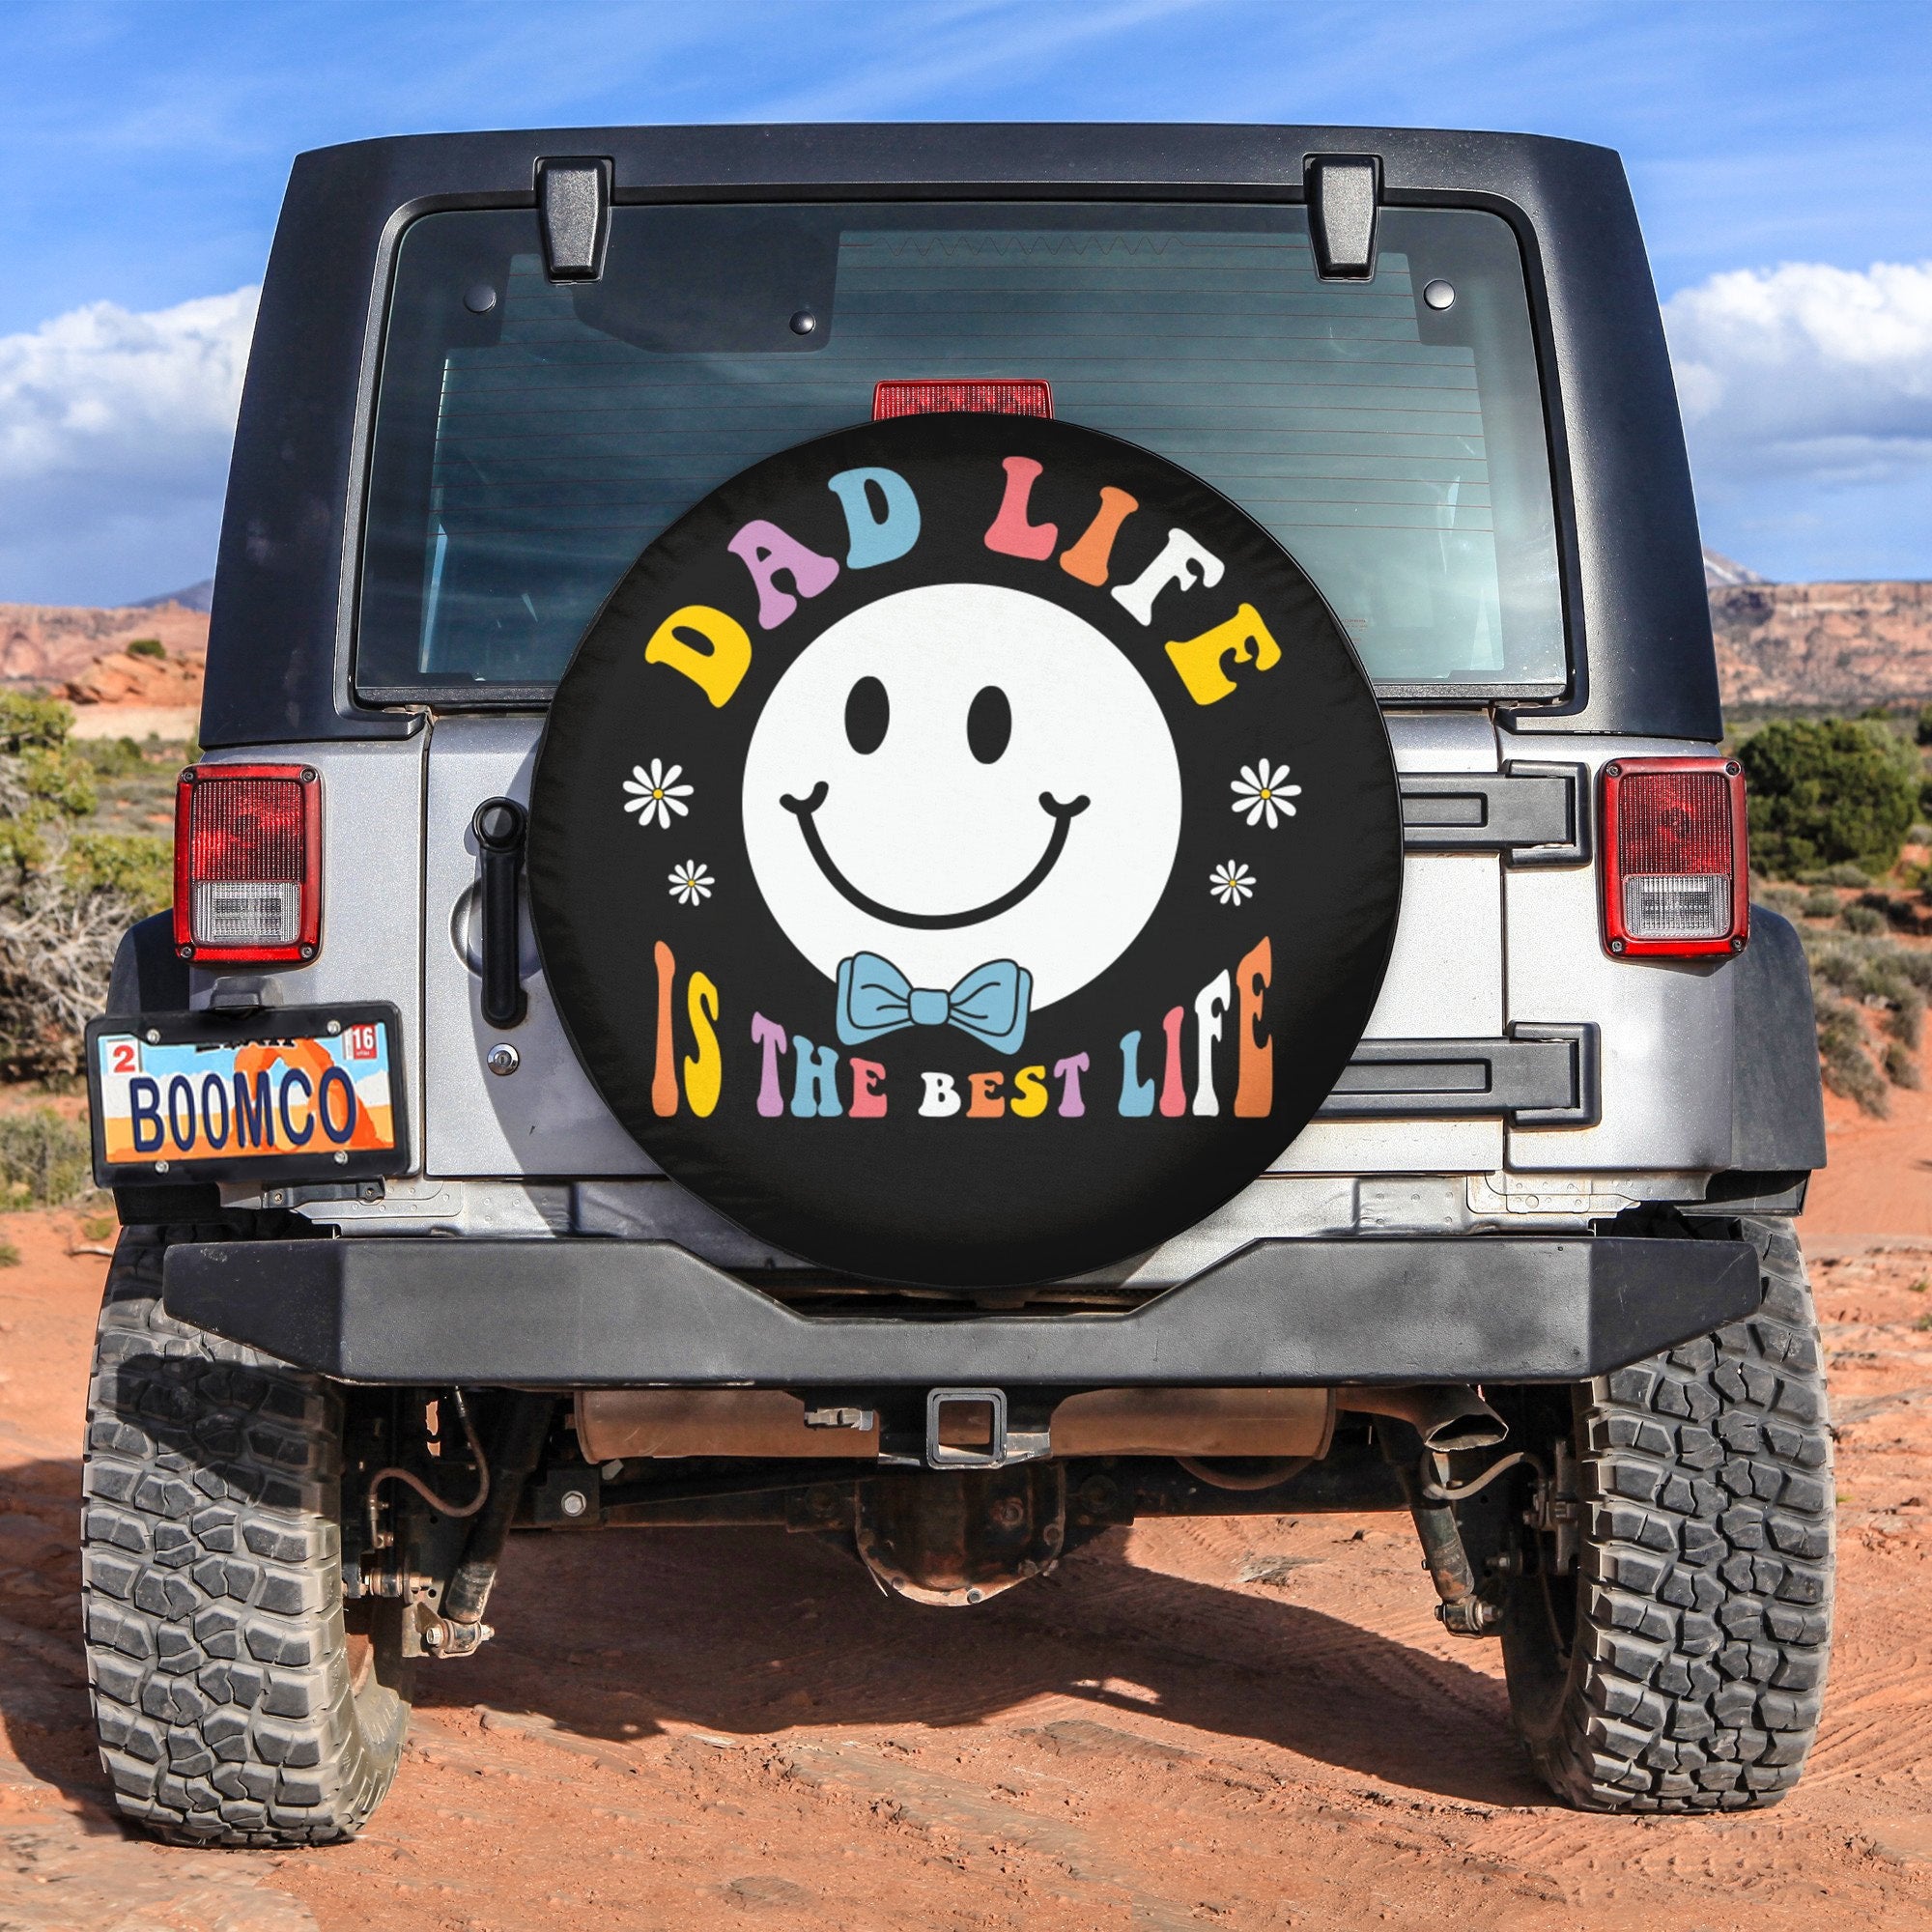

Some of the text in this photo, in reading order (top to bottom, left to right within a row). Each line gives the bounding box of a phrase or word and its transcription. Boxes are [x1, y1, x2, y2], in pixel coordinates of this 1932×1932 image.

[645, 456, 1282, 709] DAD LIFE
[113, 1044, 136, 1073] 2
[353, 1026, 375, 1050] 16
[651, 935, 1273, 1119] IS THE BEST LIFE
[129, 1065, 356, 1152] BOOMCO
